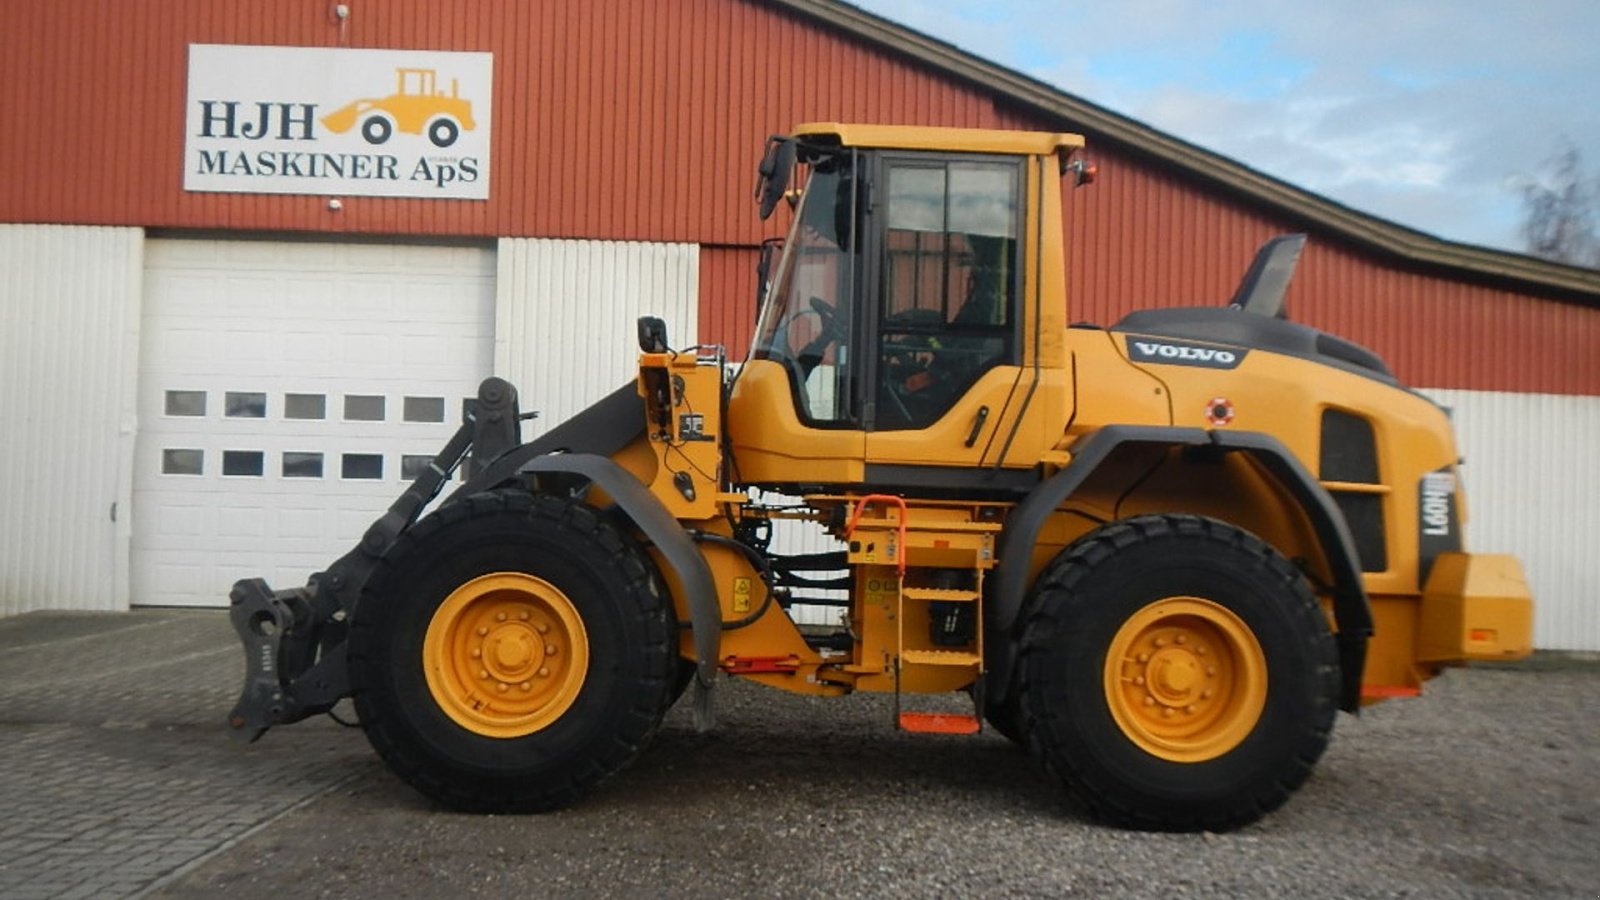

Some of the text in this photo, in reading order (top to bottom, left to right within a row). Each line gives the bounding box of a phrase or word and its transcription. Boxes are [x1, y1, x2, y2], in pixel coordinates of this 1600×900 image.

[198, 100, 318, 140] HJH
[197, 149, 479, 188] MASKINER ApS
[1134, 341, 1236, 363] VOLVO
